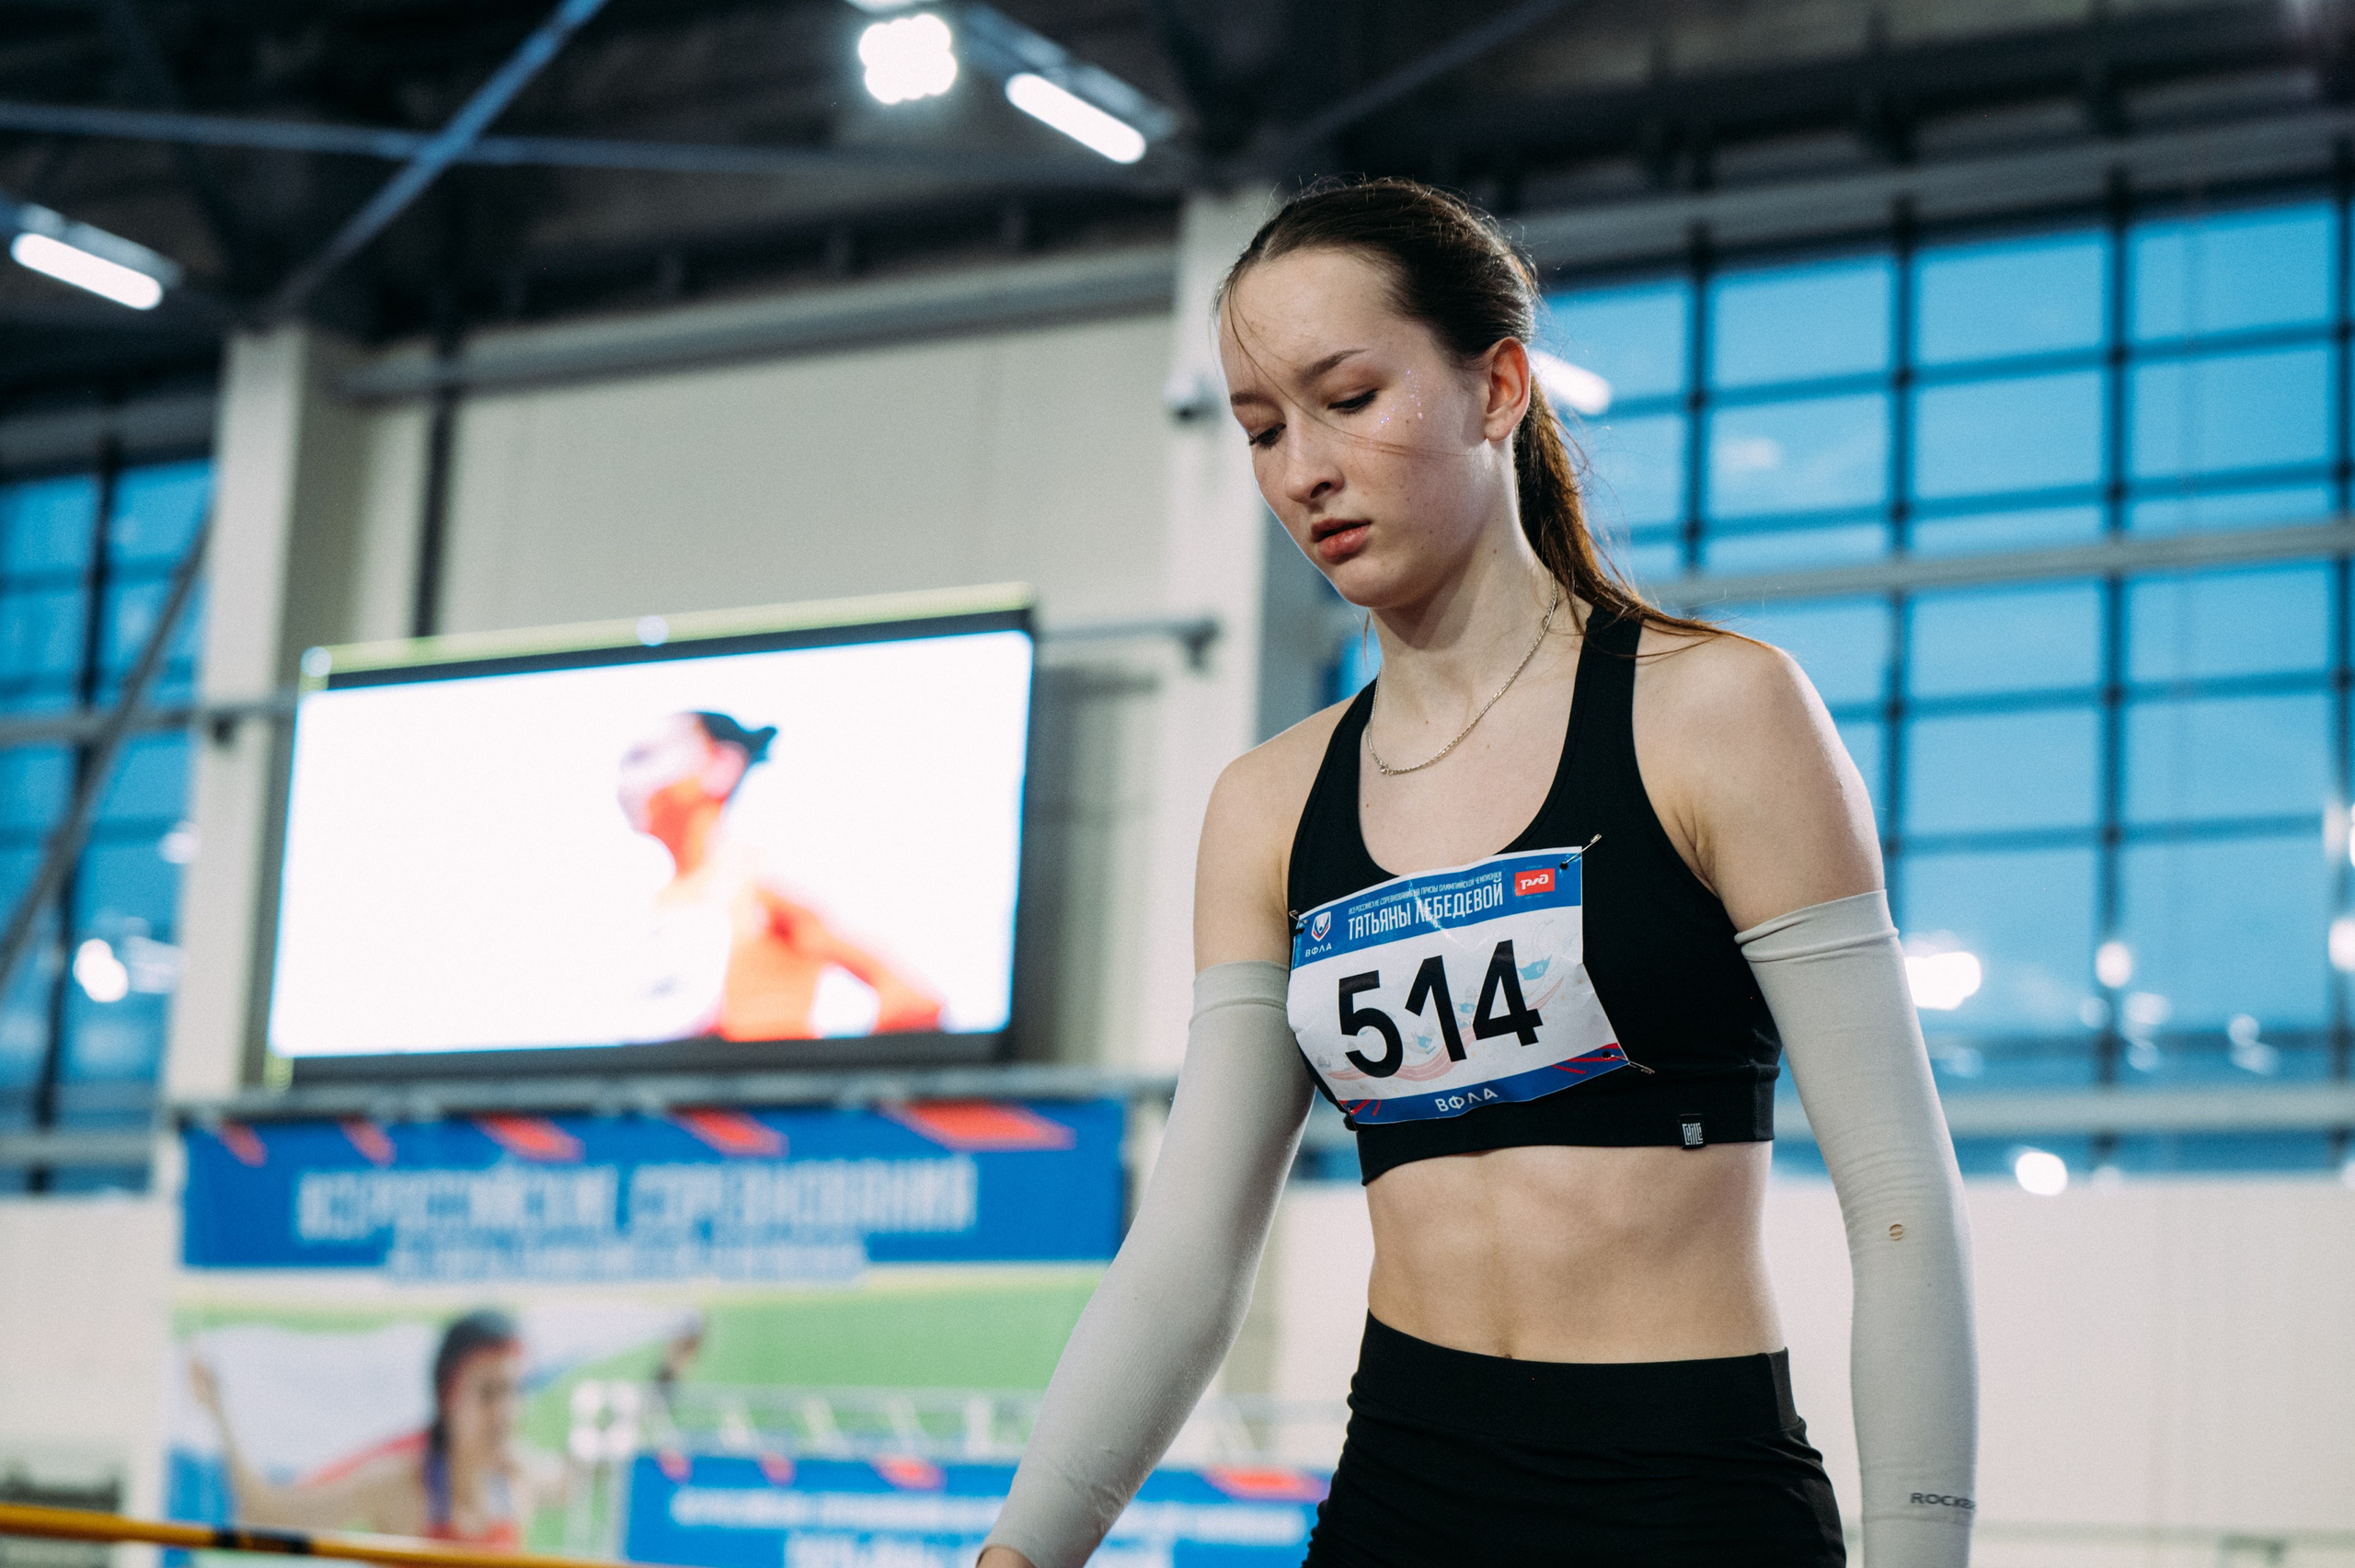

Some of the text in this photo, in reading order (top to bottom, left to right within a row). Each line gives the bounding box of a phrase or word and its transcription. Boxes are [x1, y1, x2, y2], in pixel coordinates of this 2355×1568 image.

[1420, 885, 1439, 895] ПРИЗЫ
[1439, 877, 1474, 892] ОЛИМПИЙСКОЙ
[1475, 871, 1502, 885] ЧЕМПИОНКИ
[1348, 877, 1503, 940] ТАТЬЯНЫ ЛЕБЕДЕВОЙ
[1305, 943, 1332, 957] ВФЛА
[1338, 939, 1544, 1078] 514
[1434, 1088, 1499, 1112] ВФЛА
